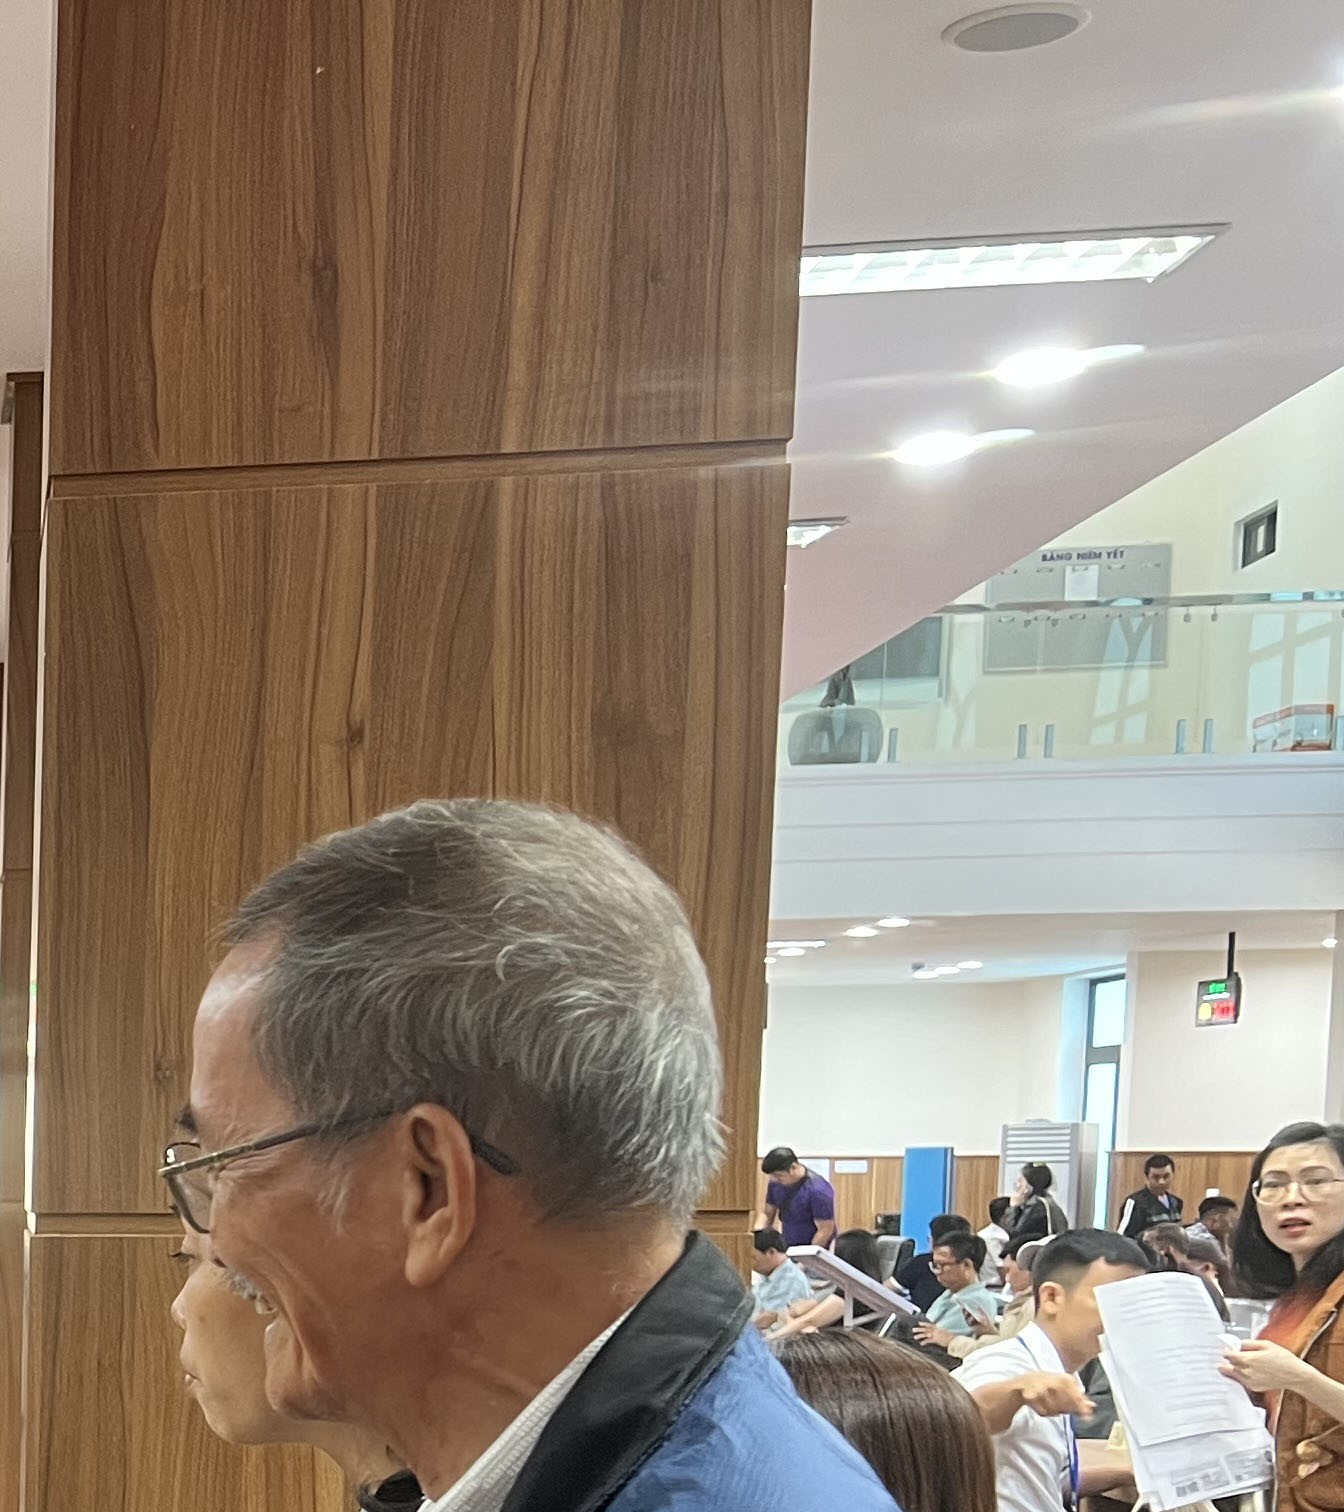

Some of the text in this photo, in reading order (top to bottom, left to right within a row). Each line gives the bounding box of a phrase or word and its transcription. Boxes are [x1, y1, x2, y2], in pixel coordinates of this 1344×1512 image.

[1041, 548, 1125, 562] BẢNG NIÊM YẾT
